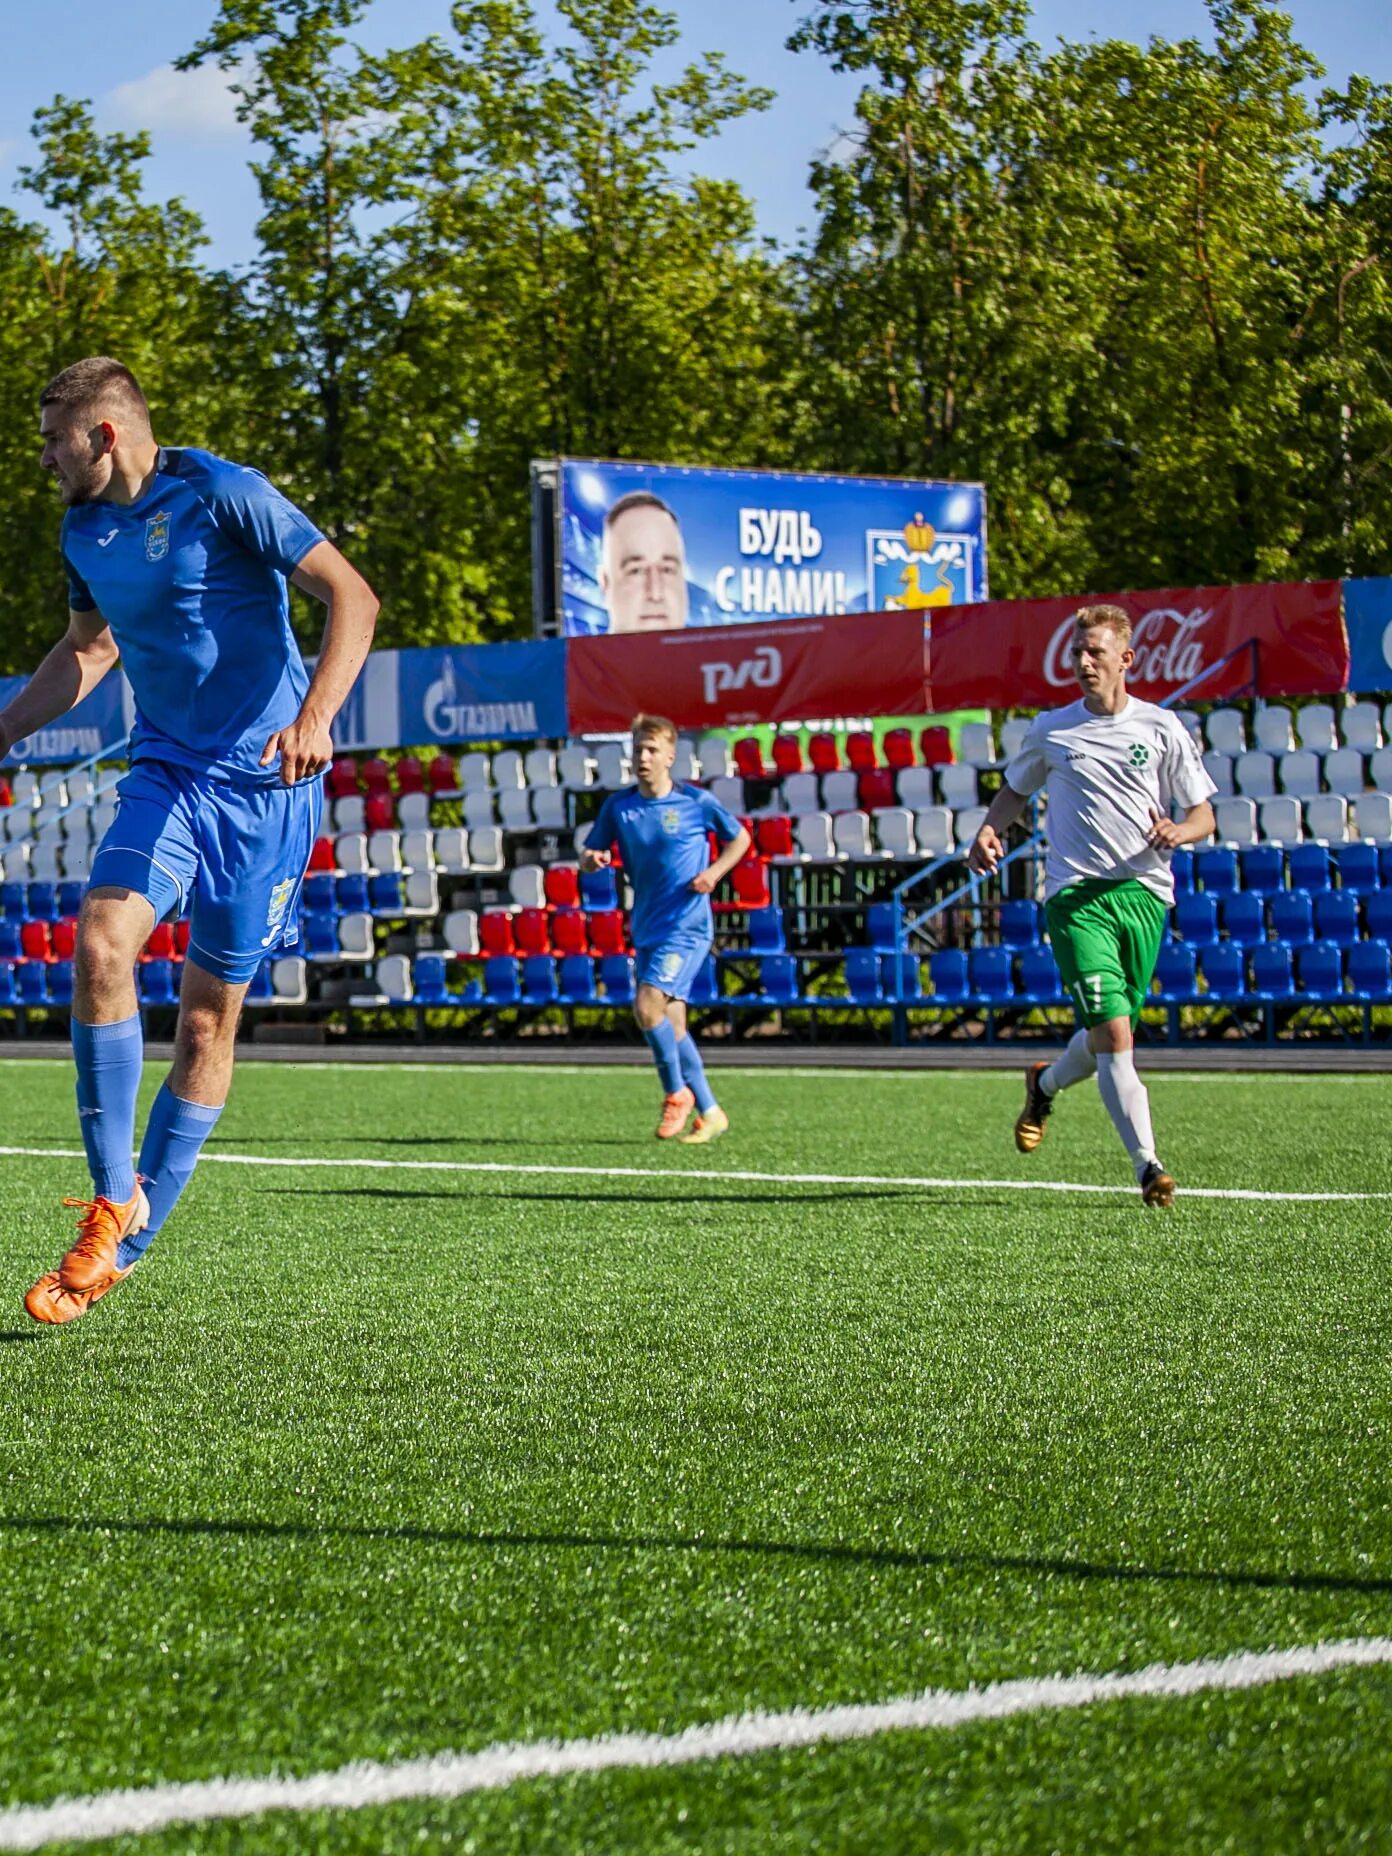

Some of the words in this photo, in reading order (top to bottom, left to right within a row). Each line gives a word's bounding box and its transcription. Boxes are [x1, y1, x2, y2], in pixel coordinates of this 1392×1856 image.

[739, 507, 823, 565] БУДЬ
[715, 566, 736, 613] С
[741, 567, 847, 616] НАМИ!
[457, 700, 539, 737] ГАЗПРОМ
